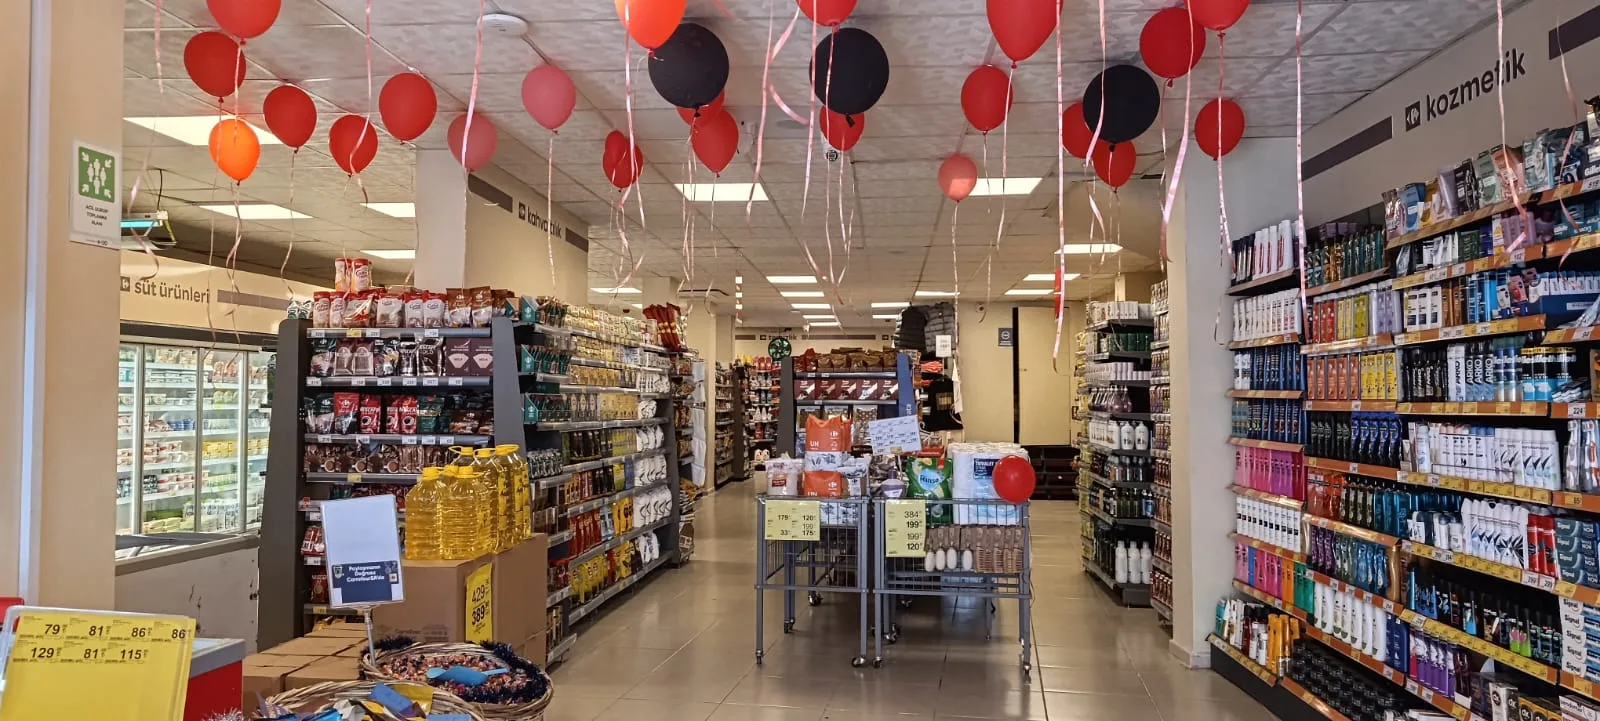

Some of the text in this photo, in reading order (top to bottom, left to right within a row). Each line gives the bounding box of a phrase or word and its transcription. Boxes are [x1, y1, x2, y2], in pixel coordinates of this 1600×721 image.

[1427, 48, 1525, 121] kozmetik
[134, 279, 209, 303] süt ürünleri
[1466, 359, 1474, 384] ARKO
[1474, 358, 1482, 384] ARKO
[1485, 358, 1494, 384] ARKO
[904, 511, 919, 519] 384
[907, 520, 920, 529] 199
[907, 543, 920, 551] 120
[472, 584, 485, 602] 429
[1563, 598, 1579, 608] Signal
[1565, 614, 1580, 625] Signal
[44, 624, 60, 635] 79
[88, 625, 104, 636] 81
[131, 627, 146, 638] 86
[171, 628, 186, 639] 86
[30, 647, 142, 660] 129 81 115
